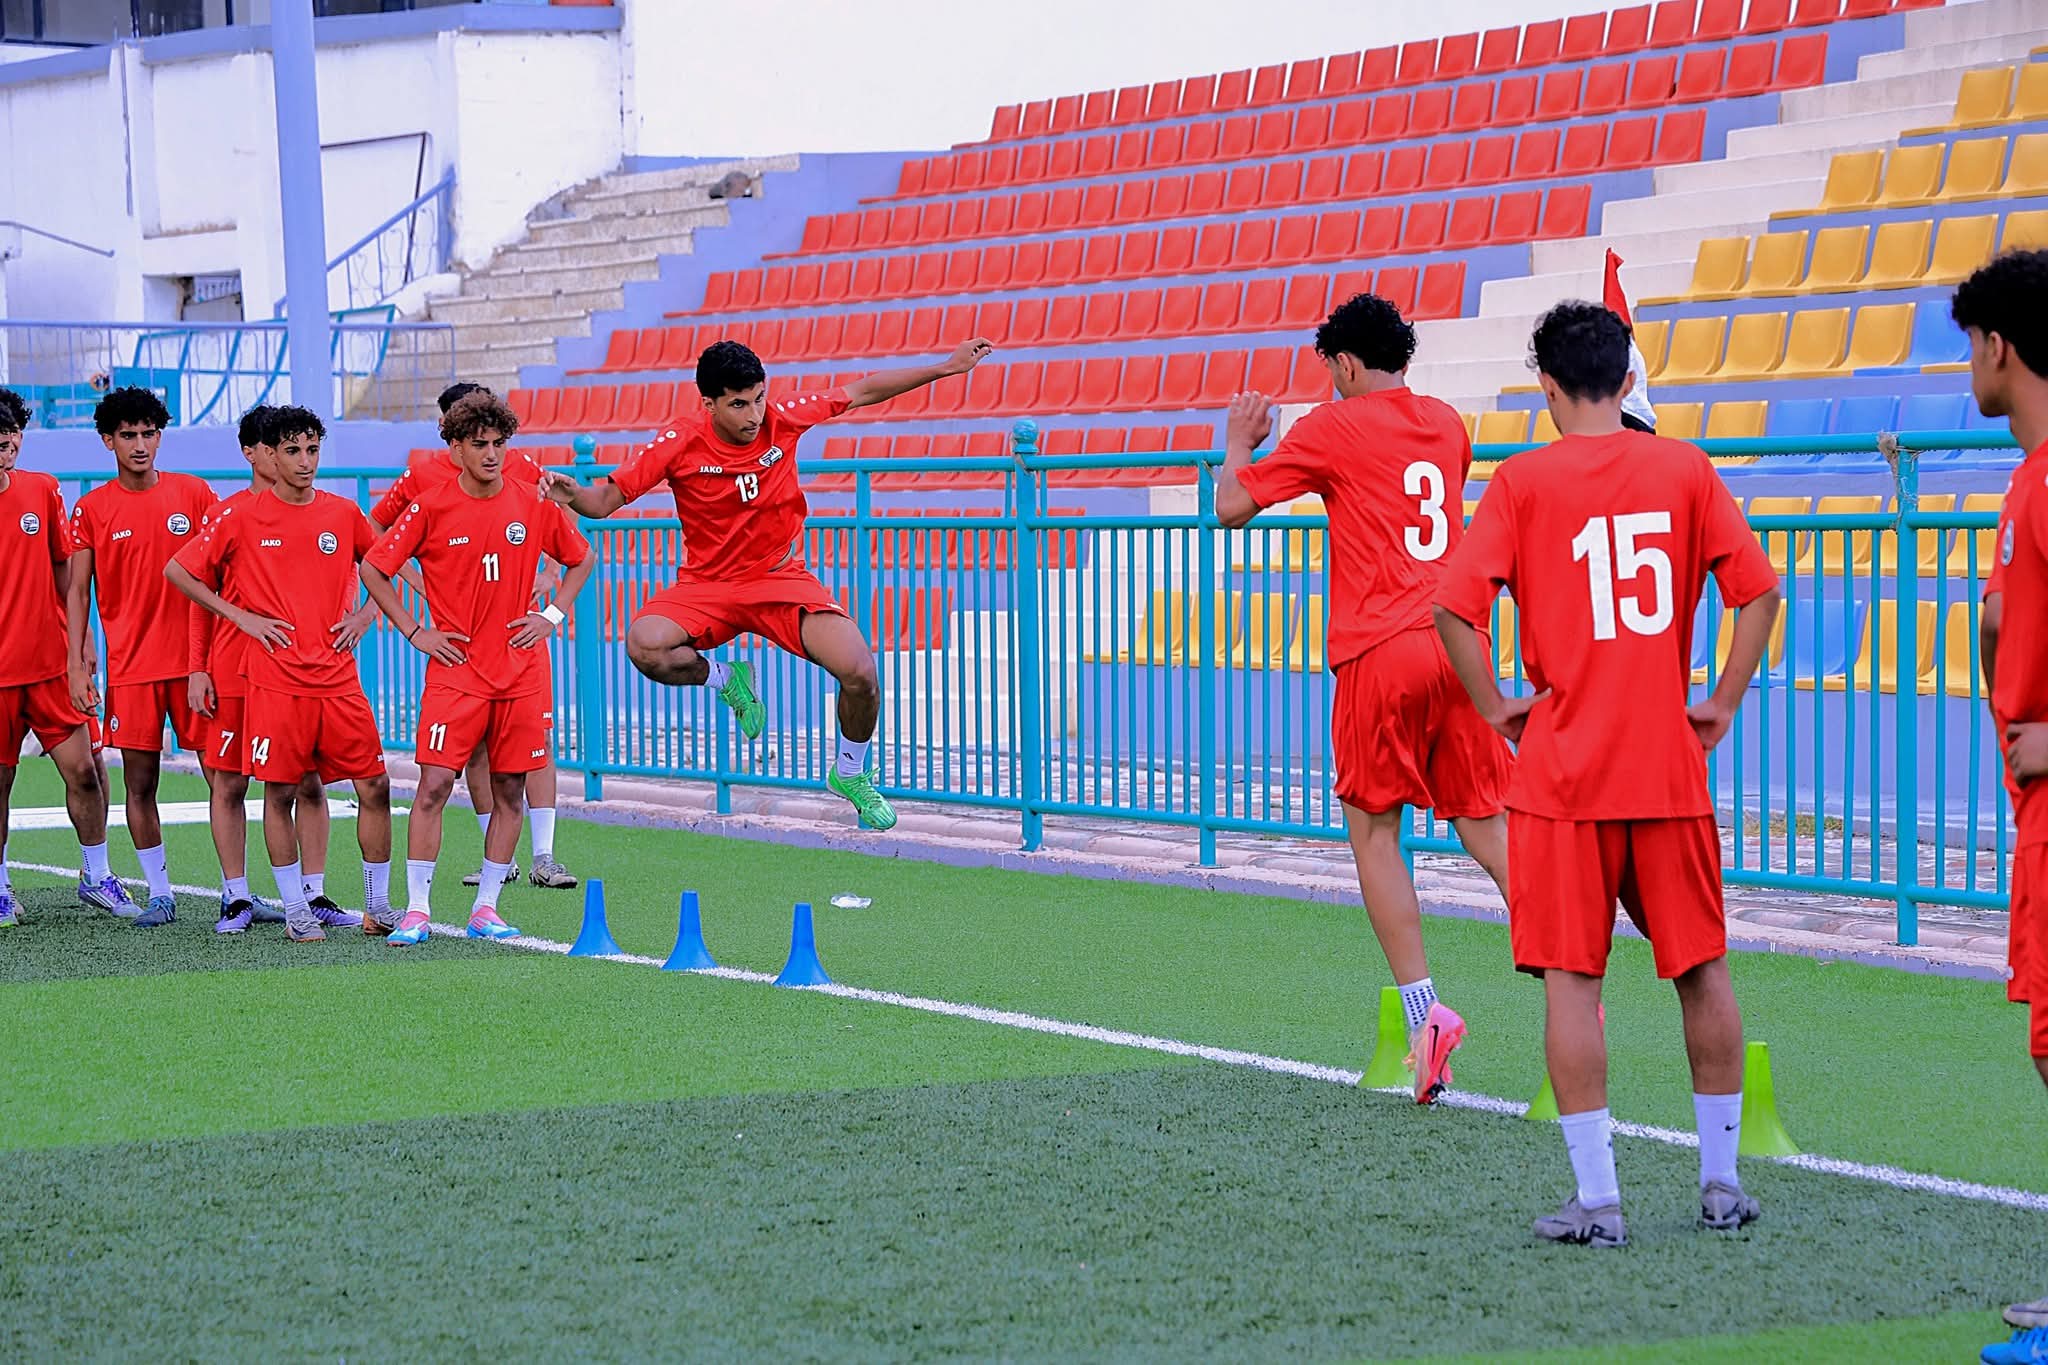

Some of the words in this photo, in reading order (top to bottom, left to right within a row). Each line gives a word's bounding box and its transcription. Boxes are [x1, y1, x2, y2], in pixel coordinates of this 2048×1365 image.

[699, 465, 723, 473] JAKO
[735, 472, 758, 503] 13
[1403, 461, 1448, 561] 3
[112, 529, 132, 541] JAKO
[260, 539, 281, 547] JAKO
[448, 536, 469, 546] JAKO
[482, 553, 499, 582] 11
[1571, 511, 1674, 641] 15
[219, 730, 234, 757] 7
[251, 736, 270, 766] 14
[429, 723, 447, 751] 11
